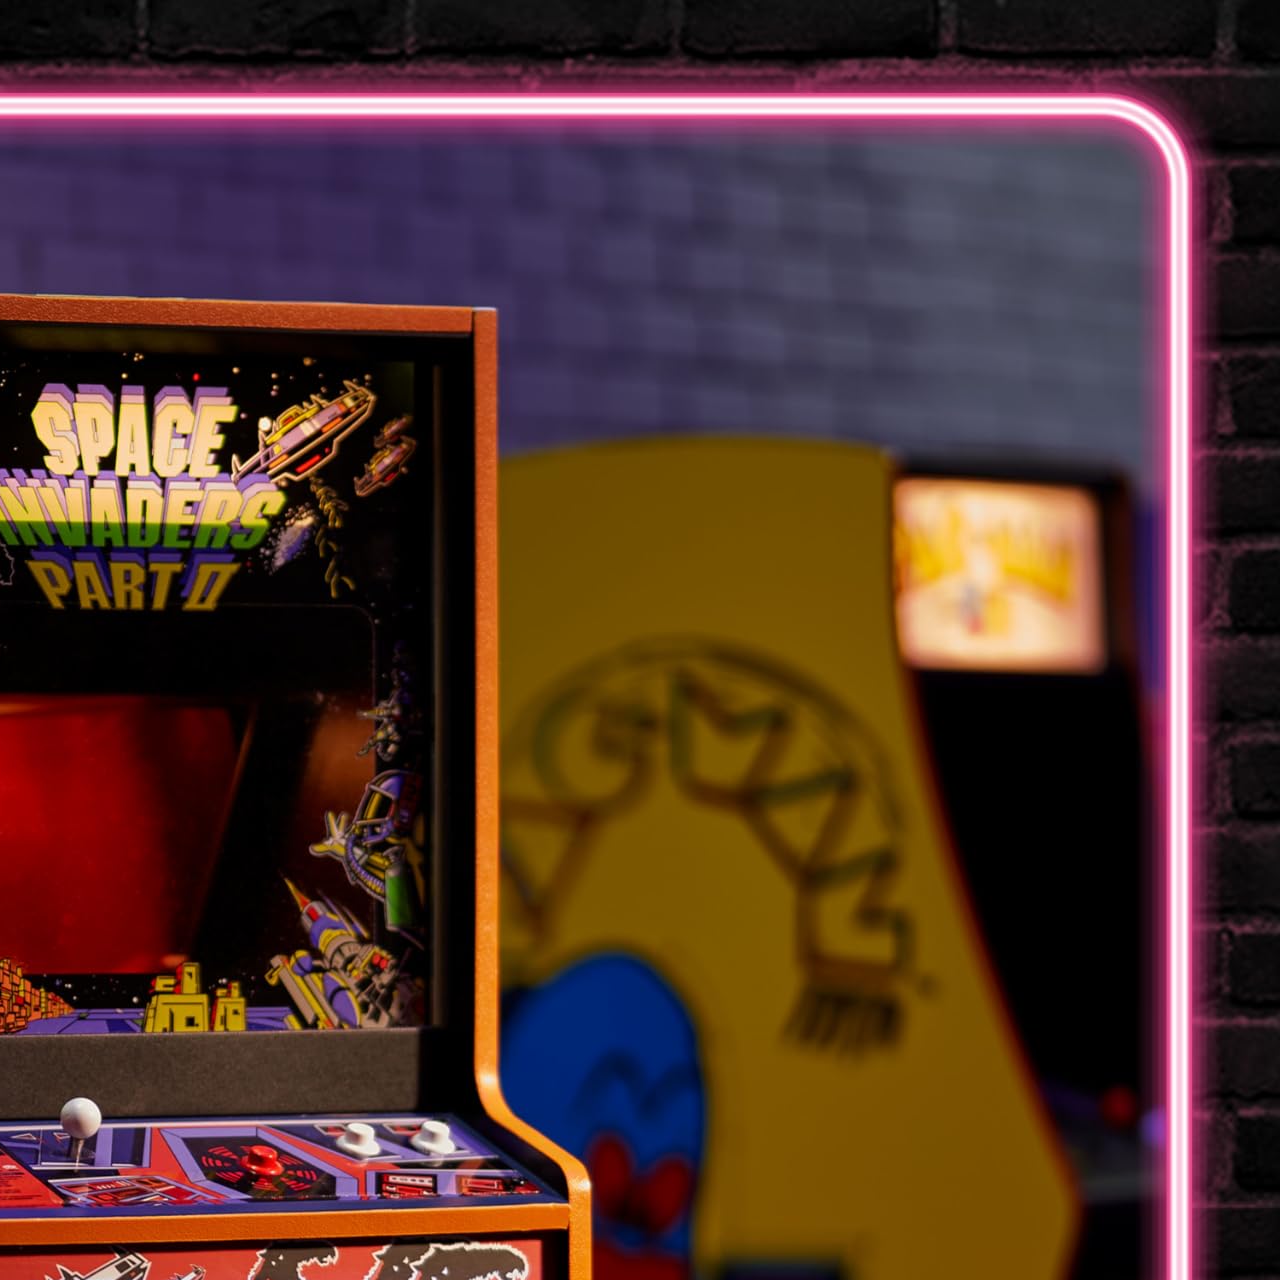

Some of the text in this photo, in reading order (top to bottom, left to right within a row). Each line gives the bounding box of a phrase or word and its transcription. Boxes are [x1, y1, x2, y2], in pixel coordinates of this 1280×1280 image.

[31, 383, 239, 478] SPACE
[24, 554, 242, 611] PART II
